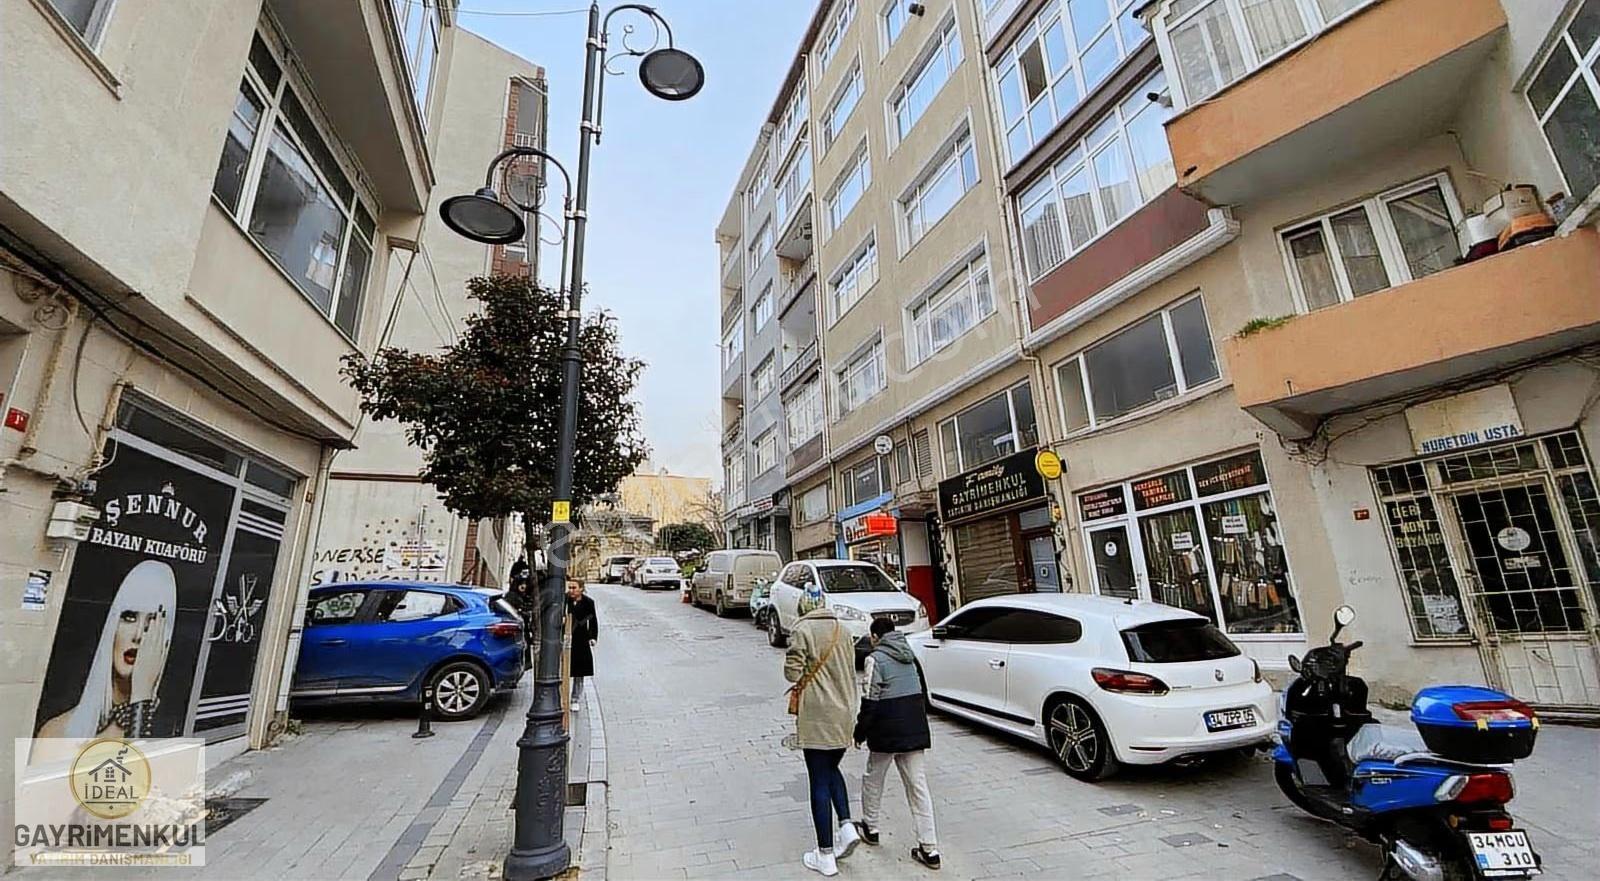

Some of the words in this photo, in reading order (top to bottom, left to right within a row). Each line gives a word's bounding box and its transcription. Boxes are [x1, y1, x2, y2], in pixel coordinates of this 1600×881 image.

[1483, 424, 1518, 440] USTA
[105, 494, 208, 544] ŞENNUR
[90, 527, 143, 552] BAYAN
[143, 542, 208, 564] KUAFÖRÜ
[1501, 852, 1532, 866] 310
